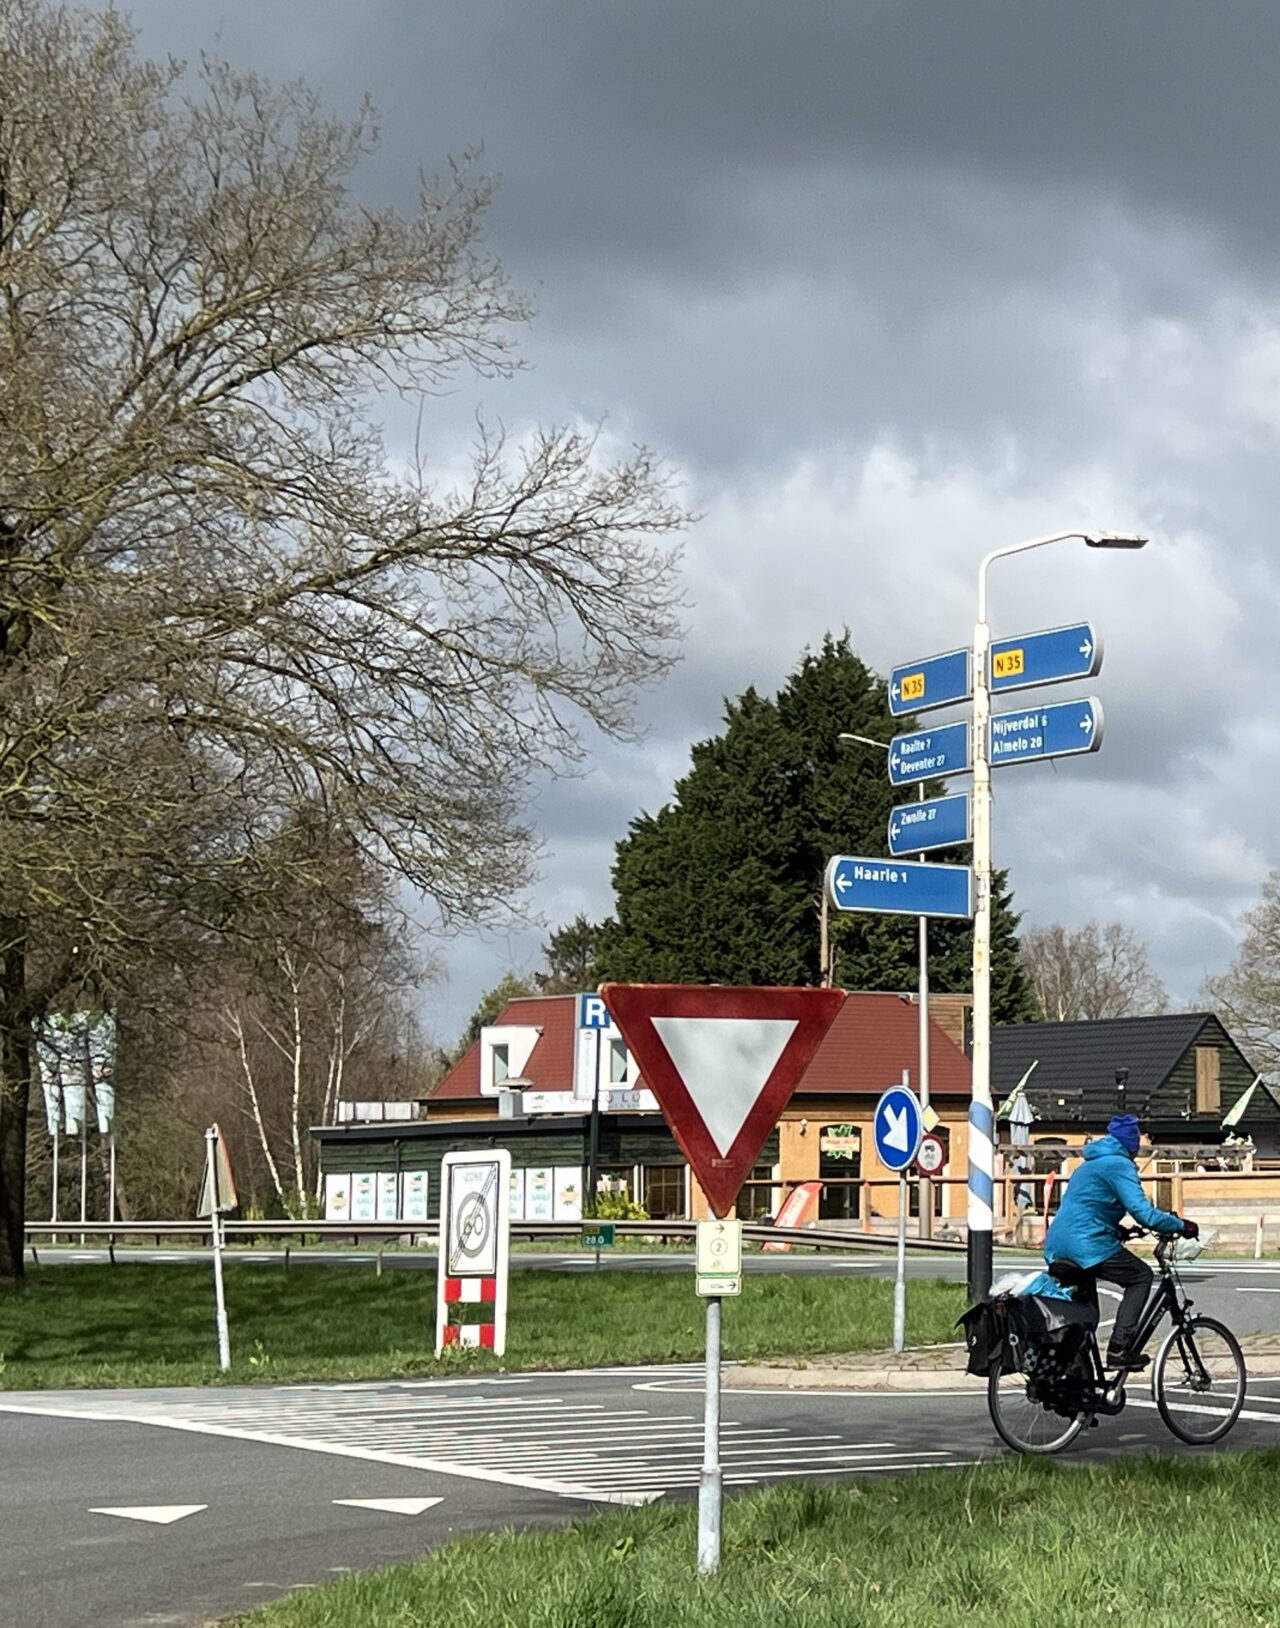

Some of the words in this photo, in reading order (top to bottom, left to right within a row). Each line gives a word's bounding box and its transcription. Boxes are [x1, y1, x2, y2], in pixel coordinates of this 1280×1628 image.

[996, 658, 1004, 672] N
[1007, 655, 1021, 671] 35
[903, 680, 910, 696] N
[912, 679, 923, 694] 35
[993, 714, 1039, 736] Nijverdal
[1041, 715, 1048, 727] 6
[993, 737, 1028, 755] Almelo
[1030, 736, 1043, 749] 20
[901, 757, 935, 775] Deventer
[936, 754, 946, 766] 27
[901, 809, 927, 826] Zwolle
[854, 866, 898, 882] Haarle
[901, 871, 907, 883] 1
